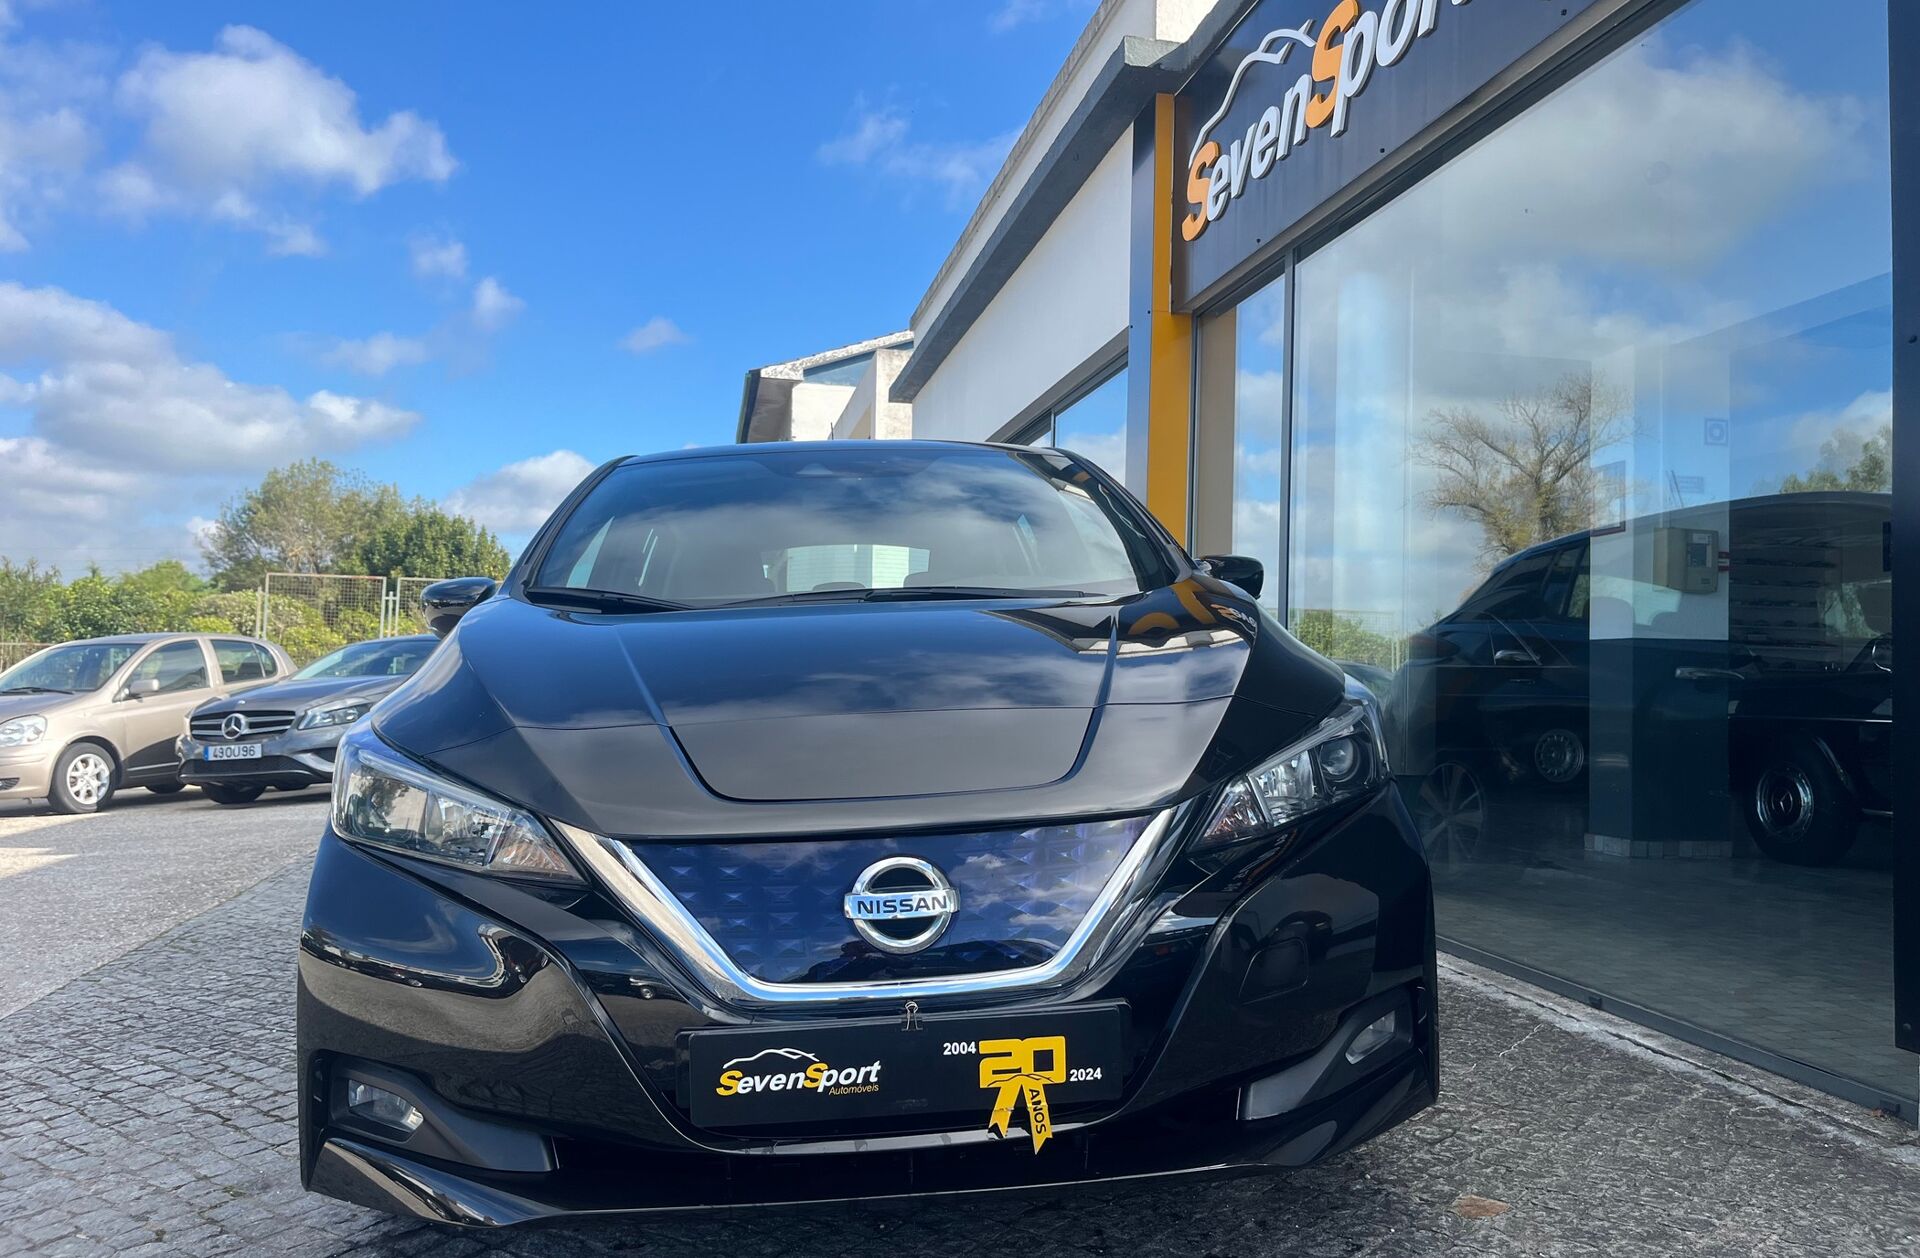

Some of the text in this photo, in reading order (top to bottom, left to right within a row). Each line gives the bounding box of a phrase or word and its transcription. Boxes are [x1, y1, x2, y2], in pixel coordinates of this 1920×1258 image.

[1182, 0, 1467, 241] SevenSpo
[857, 896, 947, 914] NISSAN
[943, 1041, 977, 1056] 2004
[979, 1035, 1067, 1089] 20
[716, 1060, 881, 1096] SevenSport
[1069, 1067, 1103, 1082] 2024
[829, 1083, 880, 1096] Automóveis
[1029, 1088, 1047, 1135] ANOS
